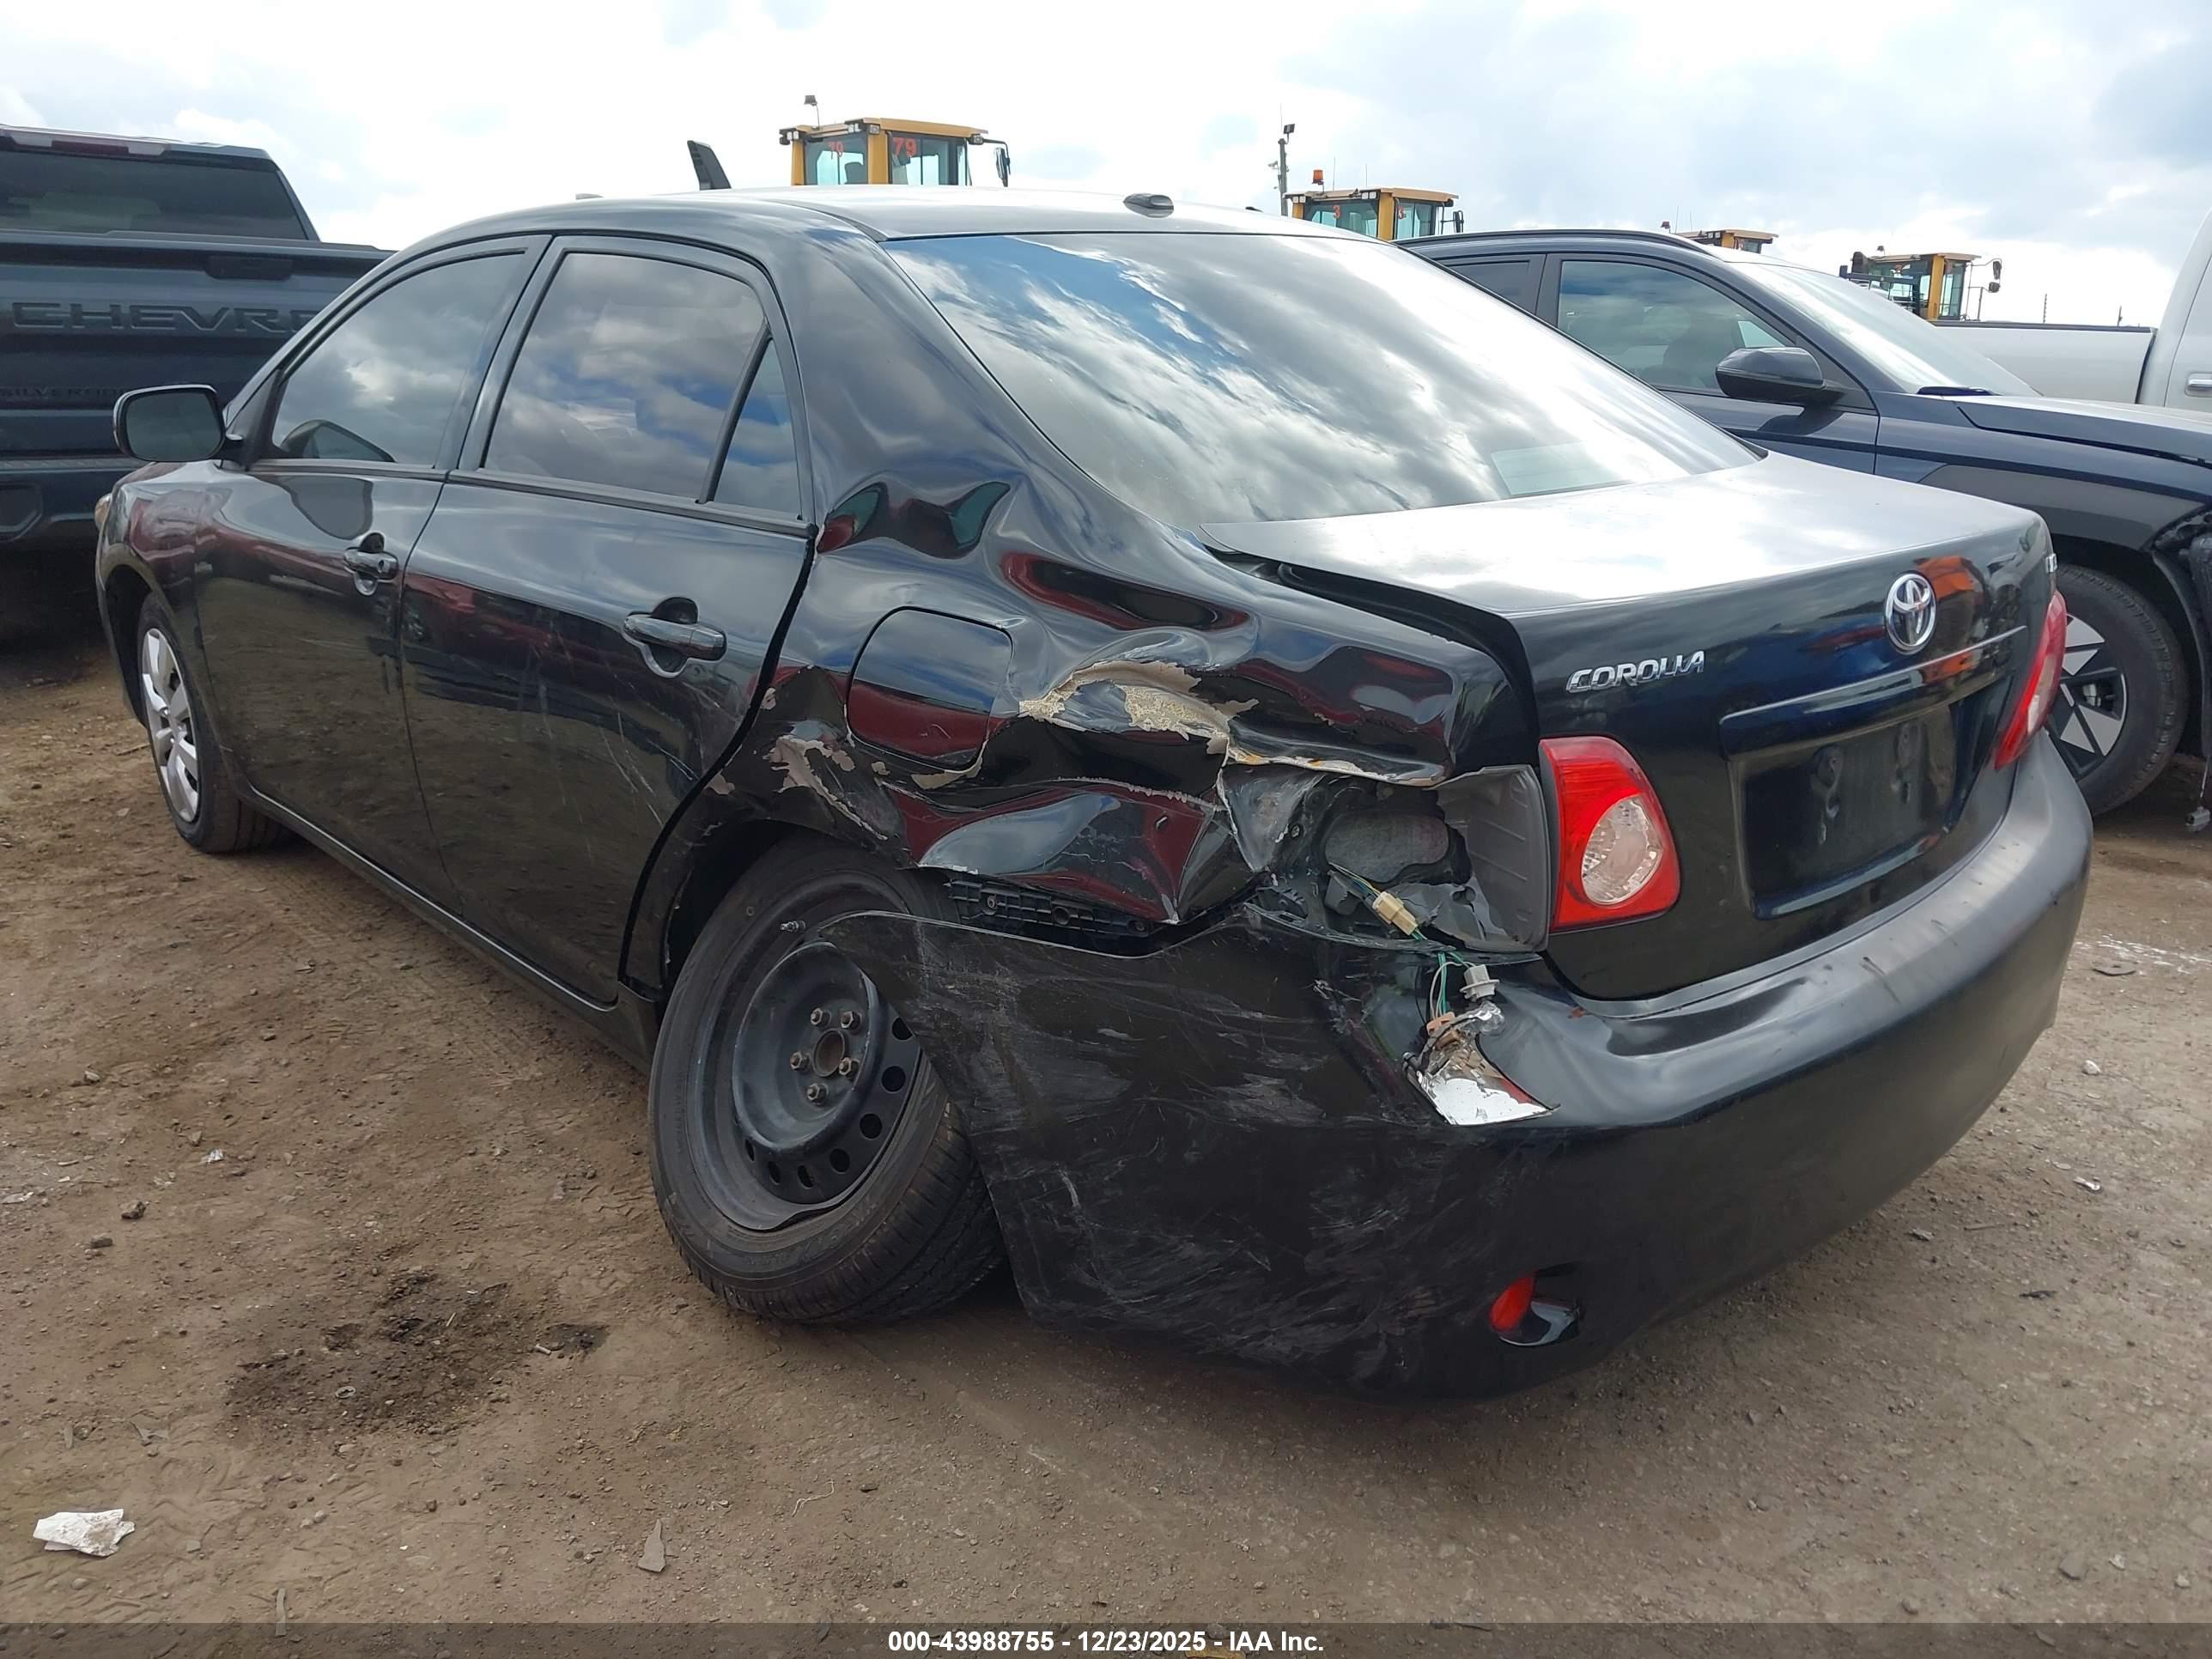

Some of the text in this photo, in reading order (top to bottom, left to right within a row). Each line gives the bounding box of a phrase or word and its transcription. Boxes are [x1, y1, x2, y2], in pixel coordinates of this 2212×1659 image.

[892, 137, 918, 157] 79
[1333, 204, 1341, 220] 3
[1566, 650, 1705, 694] COROLLA
